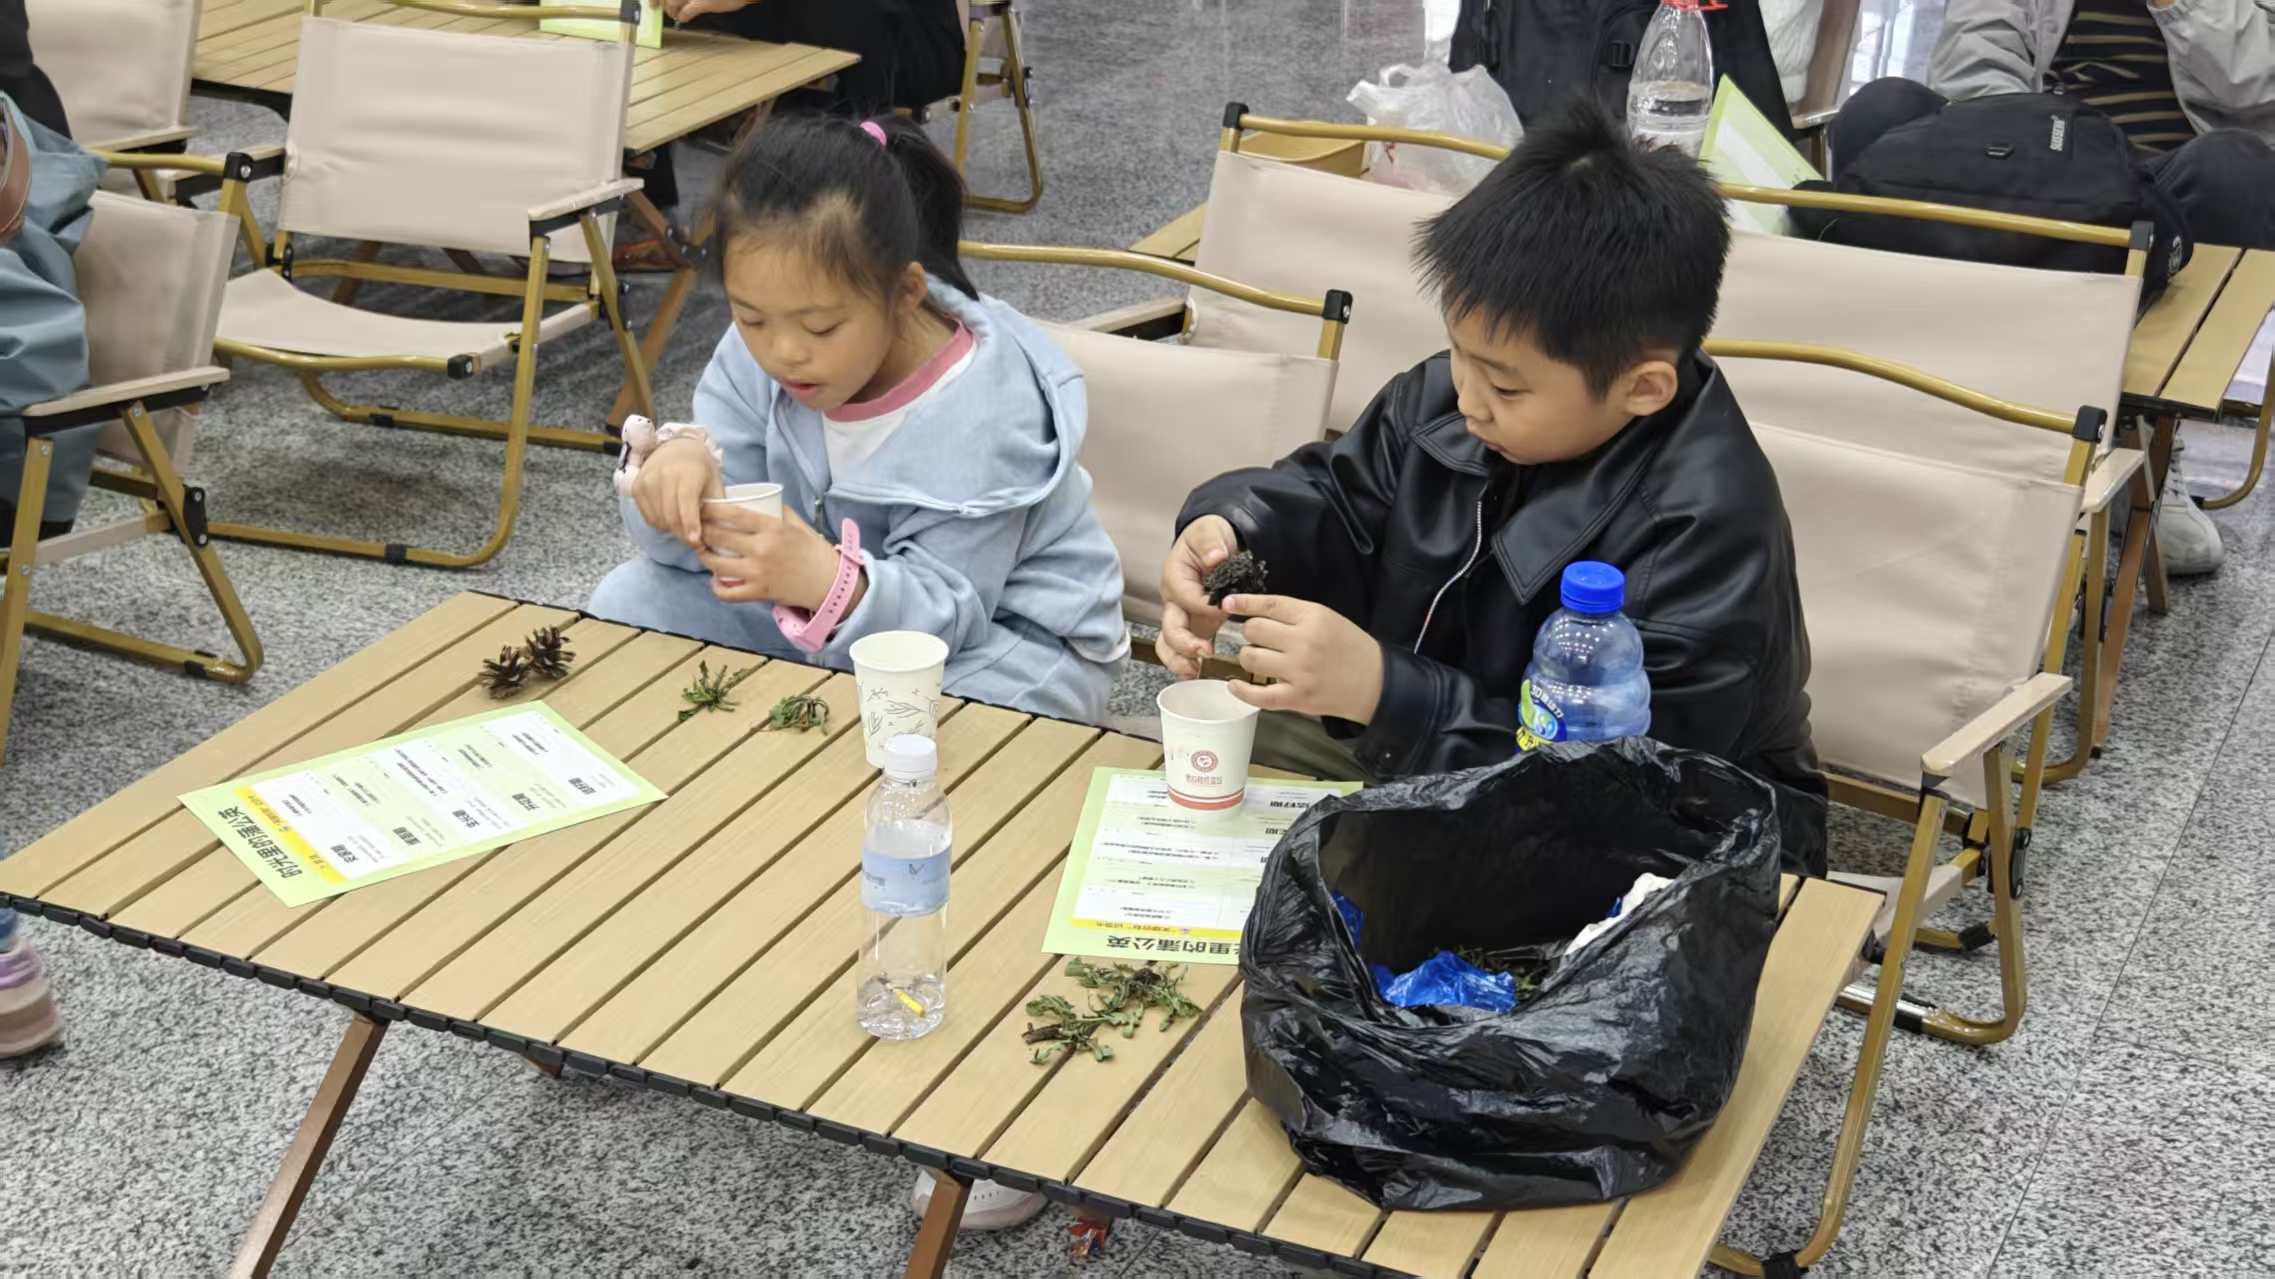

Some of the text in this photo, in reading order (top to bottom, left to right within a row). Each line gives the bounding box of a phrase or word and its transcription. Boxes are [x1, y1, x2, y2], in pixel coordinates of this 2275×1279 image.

[217, 806, 303, 879] 时光里的蒲公英
